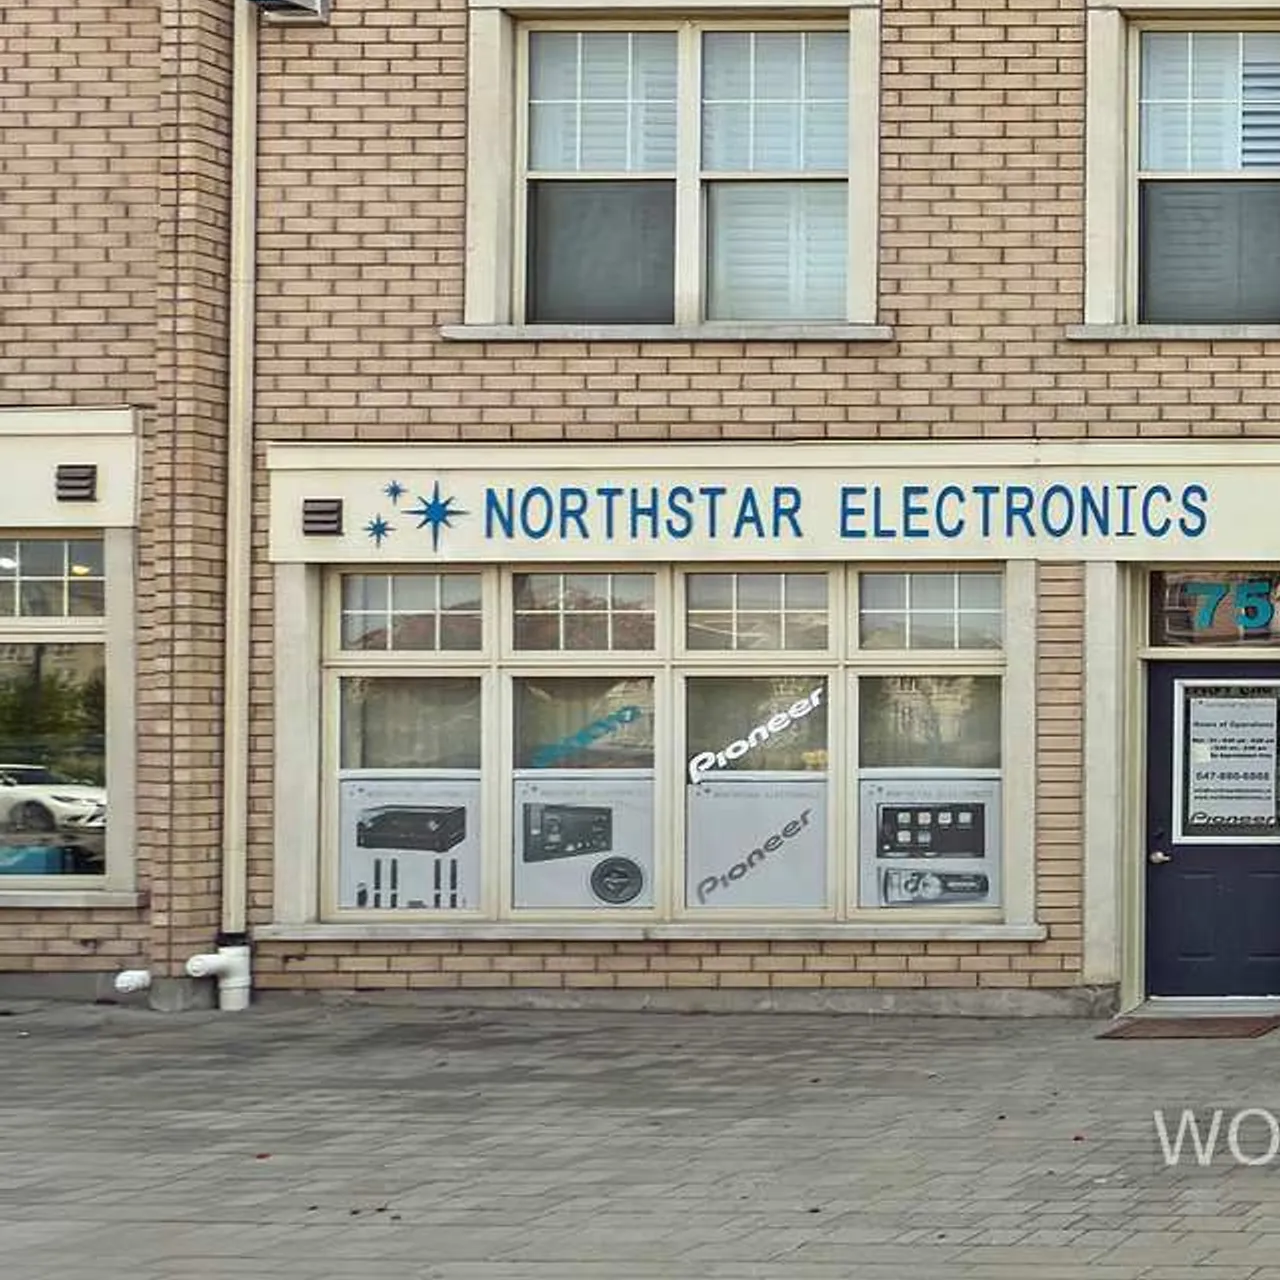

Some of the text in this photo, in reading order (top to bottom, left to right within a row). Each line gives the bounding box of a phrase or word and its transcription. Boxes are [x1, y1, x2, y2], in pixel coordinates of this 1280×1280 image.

[485, 483, 1209, 540] NORTHSTAR ELECTRONICS
[1182, 579, 1274, 630] 75
[689, 686, 824, 784] Pioneer
[696, 808, 812, 904] Pioneer
